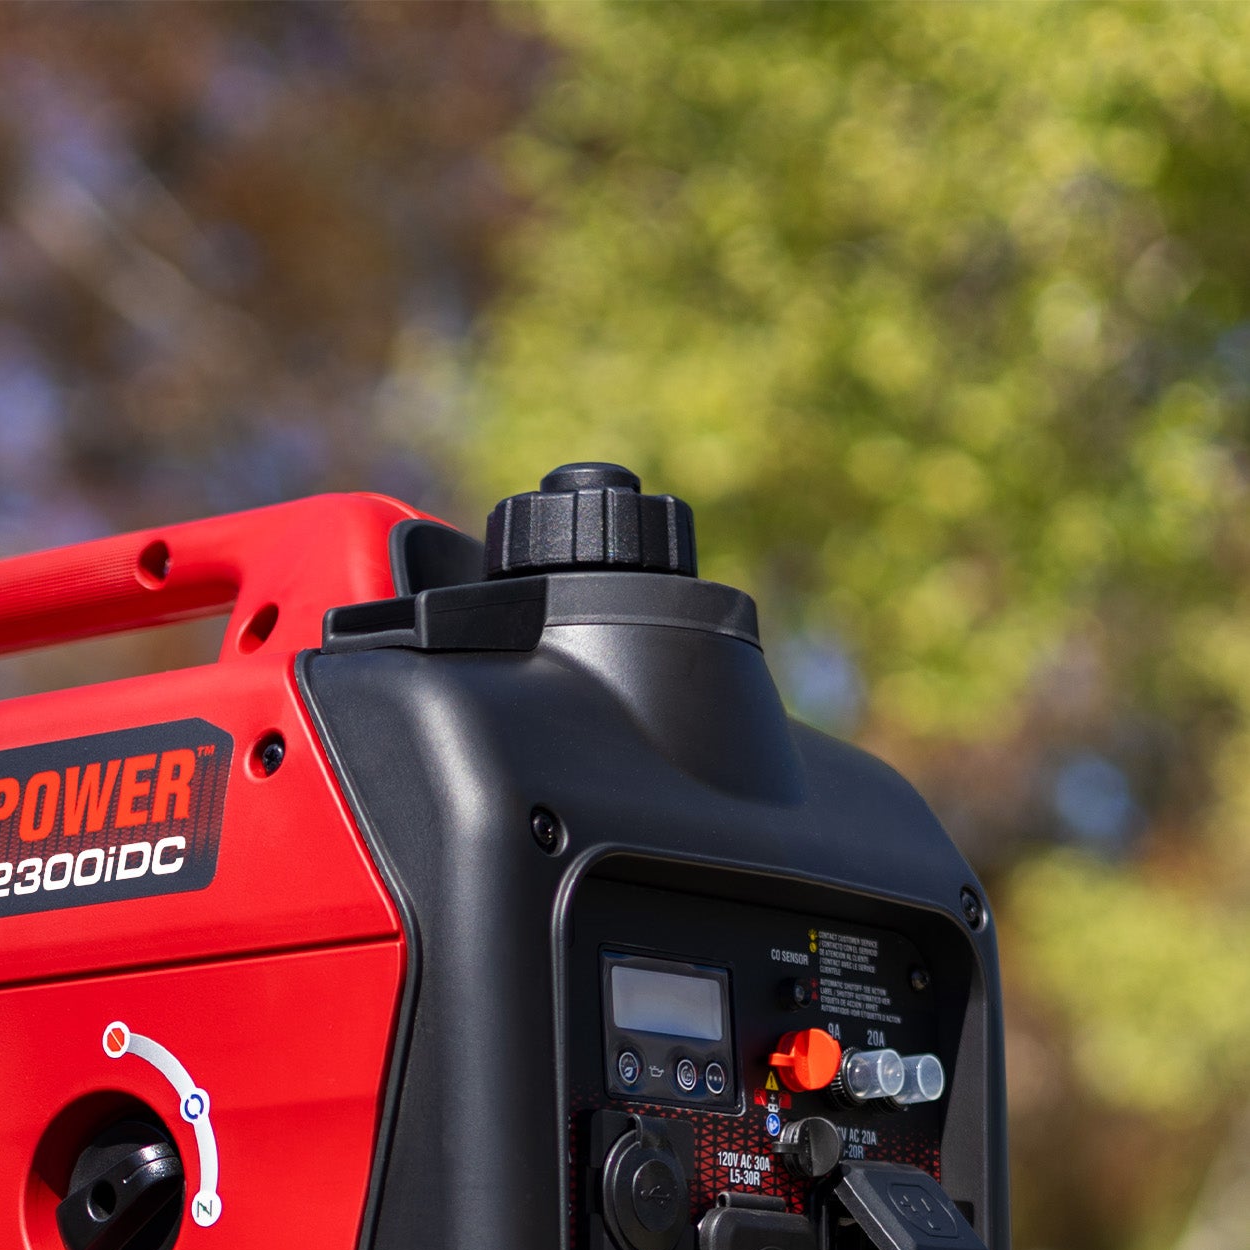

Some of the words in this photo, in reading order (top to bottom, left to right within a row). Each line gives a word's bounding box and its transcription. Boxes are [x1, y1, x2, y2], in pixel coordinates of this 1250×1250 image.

[770, 949, 781, 961] CO
[781, 950, 809, 966] SENSOR
[866, 1030, 885, 1047] 20A
[849, 1127, 859, 1143] AC
[861, 1130, 877, 1146] 20A
[717, 1151, 739, 1168] 120V
[740, 1153, 753, 1169] AC
[753, 1155, 771, 1172] 30A
[729, 1168, 760, 1186] L5-30R
